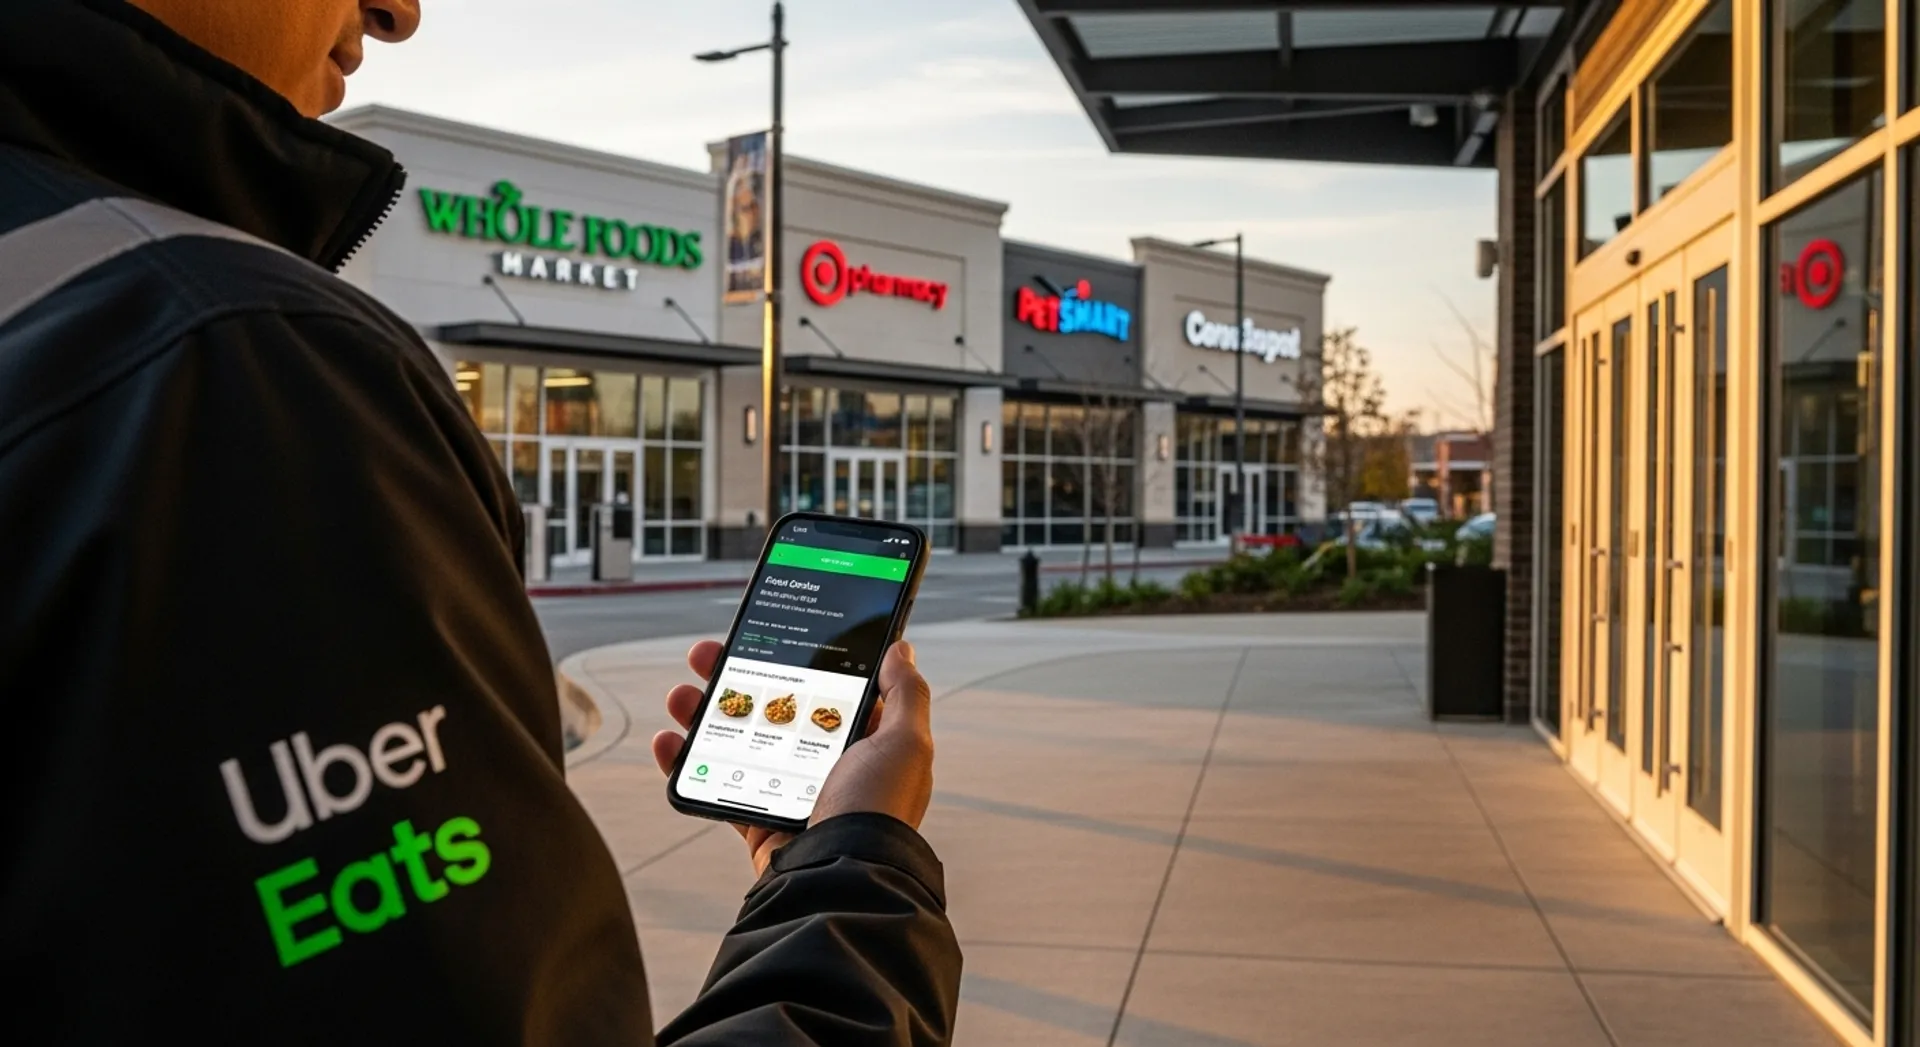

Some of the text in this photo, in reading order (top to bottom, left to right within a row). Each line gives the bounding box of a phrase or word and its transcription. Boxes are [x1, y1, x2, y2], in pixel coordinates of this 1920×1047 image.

[418, 180, 703, 270] WHOLE FOODS
[501, 251, 639, 290] MARKET
[219, 704, 447, 845] Uber
[254, 816, 491, 968] Eats
